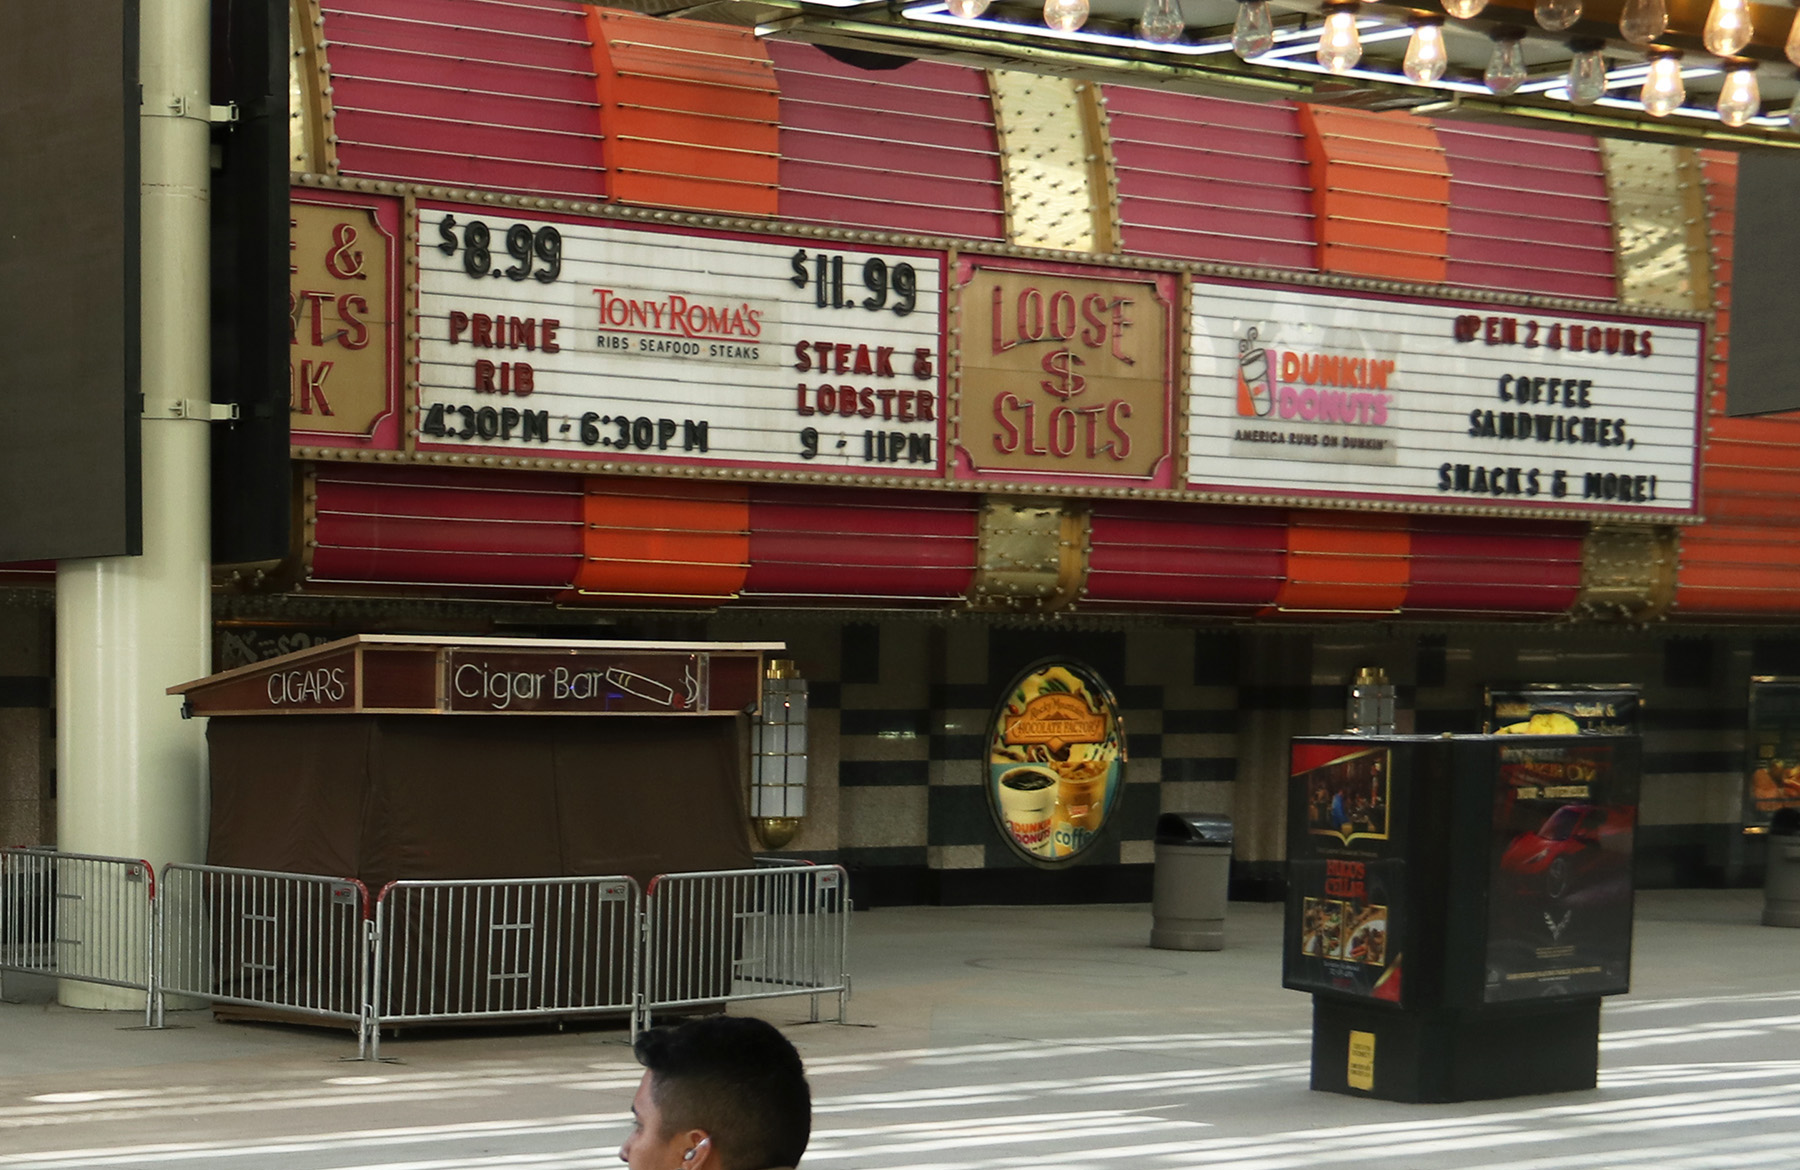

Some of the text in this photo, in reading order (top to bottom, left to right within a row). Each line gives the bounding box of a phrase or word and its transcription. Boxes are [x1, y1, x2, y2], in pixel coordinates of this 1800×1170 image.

[439, 214, 562, 284] $8.99
[790, 249, 917, 316] $11.99
[449, 311, 561, 354] PRIME
[992, 285, 1136, 366] LOOSE
[1454, 314, 1517, 345] OPEN
[1568, 324, 1653, 358] HOURS
[597, 336, 759, 360] RIBS SEAFOOD STEAKS
[795, 340, 933, 380] STEAK &
[475, 358, 535, 396] RIB
[1499, 373, 1593, 408] COFFEE
[423, 403, 549, 443] 4:30PM
[797, 383, 935, 423] LOBSTER
[1279, 386, 1388, 425] DONUTS
[800, 427, 819, 460] 9
[864, 429, 932, 463] 11PM
[993, 390, 1133, 460] SLOTS
[1234, 429, 1285, 444] AMERICA
[1288, 432, 1318, 447] RUNS
[1322, 434, 1338, 447] ON
[1468, 408, 1635, 451] SANDWICHES,
[1438, 462, 1657, 503] SNACKS & MORE!
[267, 668, 346, 704] CIGARS
[454, 663, 604, 709] Cigar Bar
